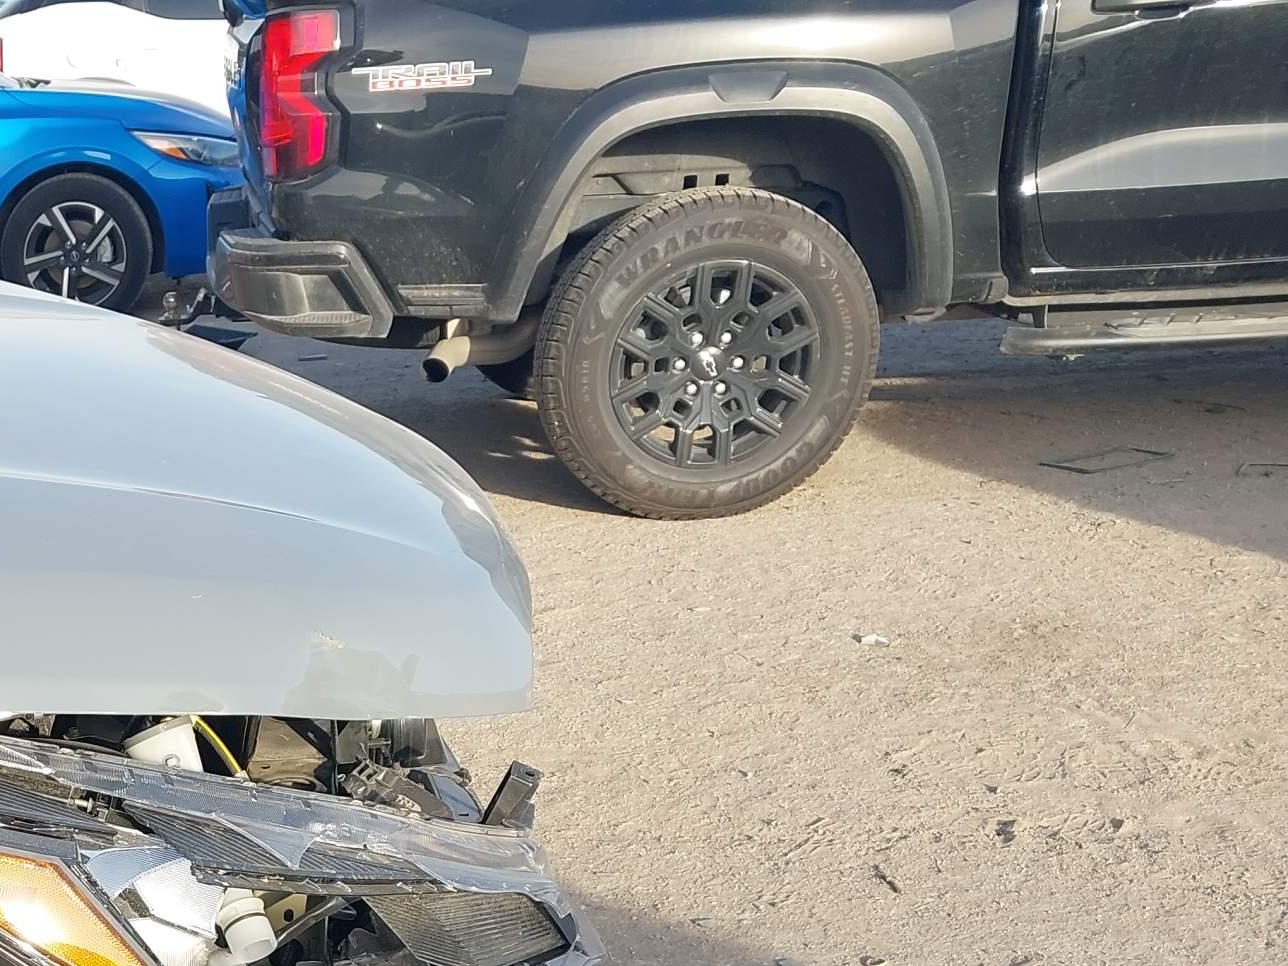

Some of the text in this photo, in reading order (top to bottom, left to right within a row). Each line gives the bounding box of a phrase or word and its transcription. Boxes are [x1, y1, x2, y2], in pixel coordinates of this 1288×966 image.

[352, 60, 493, 80] TRAIL
[369, 76, 475, 92] BOSS
[615, 217, 789, 289] WRANGLER
